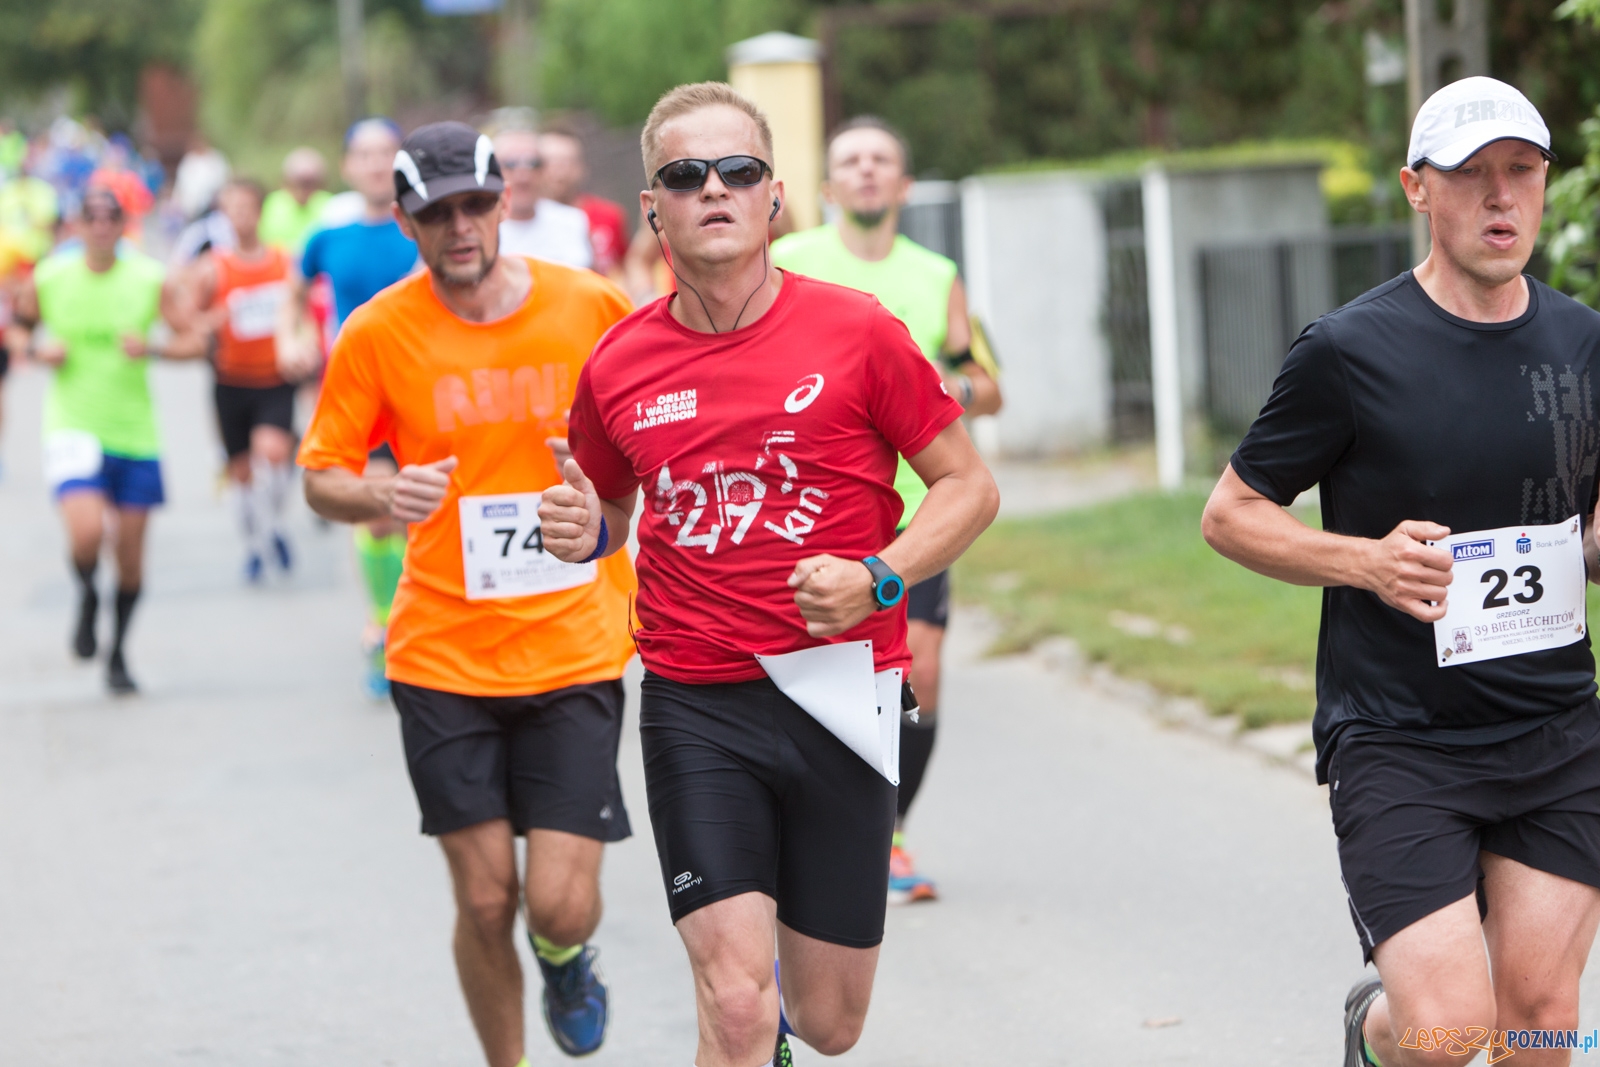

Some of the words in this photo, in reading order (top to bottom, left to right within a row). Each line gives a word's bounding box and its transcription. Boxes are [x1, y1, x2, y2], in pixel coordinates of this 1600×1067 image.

[656, 389, 697, 405] ORLEN
[645, 399, 697, 418] WARSAW
[633, 409, 697, 431] MARATHON
[763, 486, 830, 545] km
[1480, 565, 1544, 610] 23
[1496, 608, 1531, 619] GRZEGORZ
[1474, 625, 1488, 636] 39
[1491, 620, 1517, 633] BIEG
